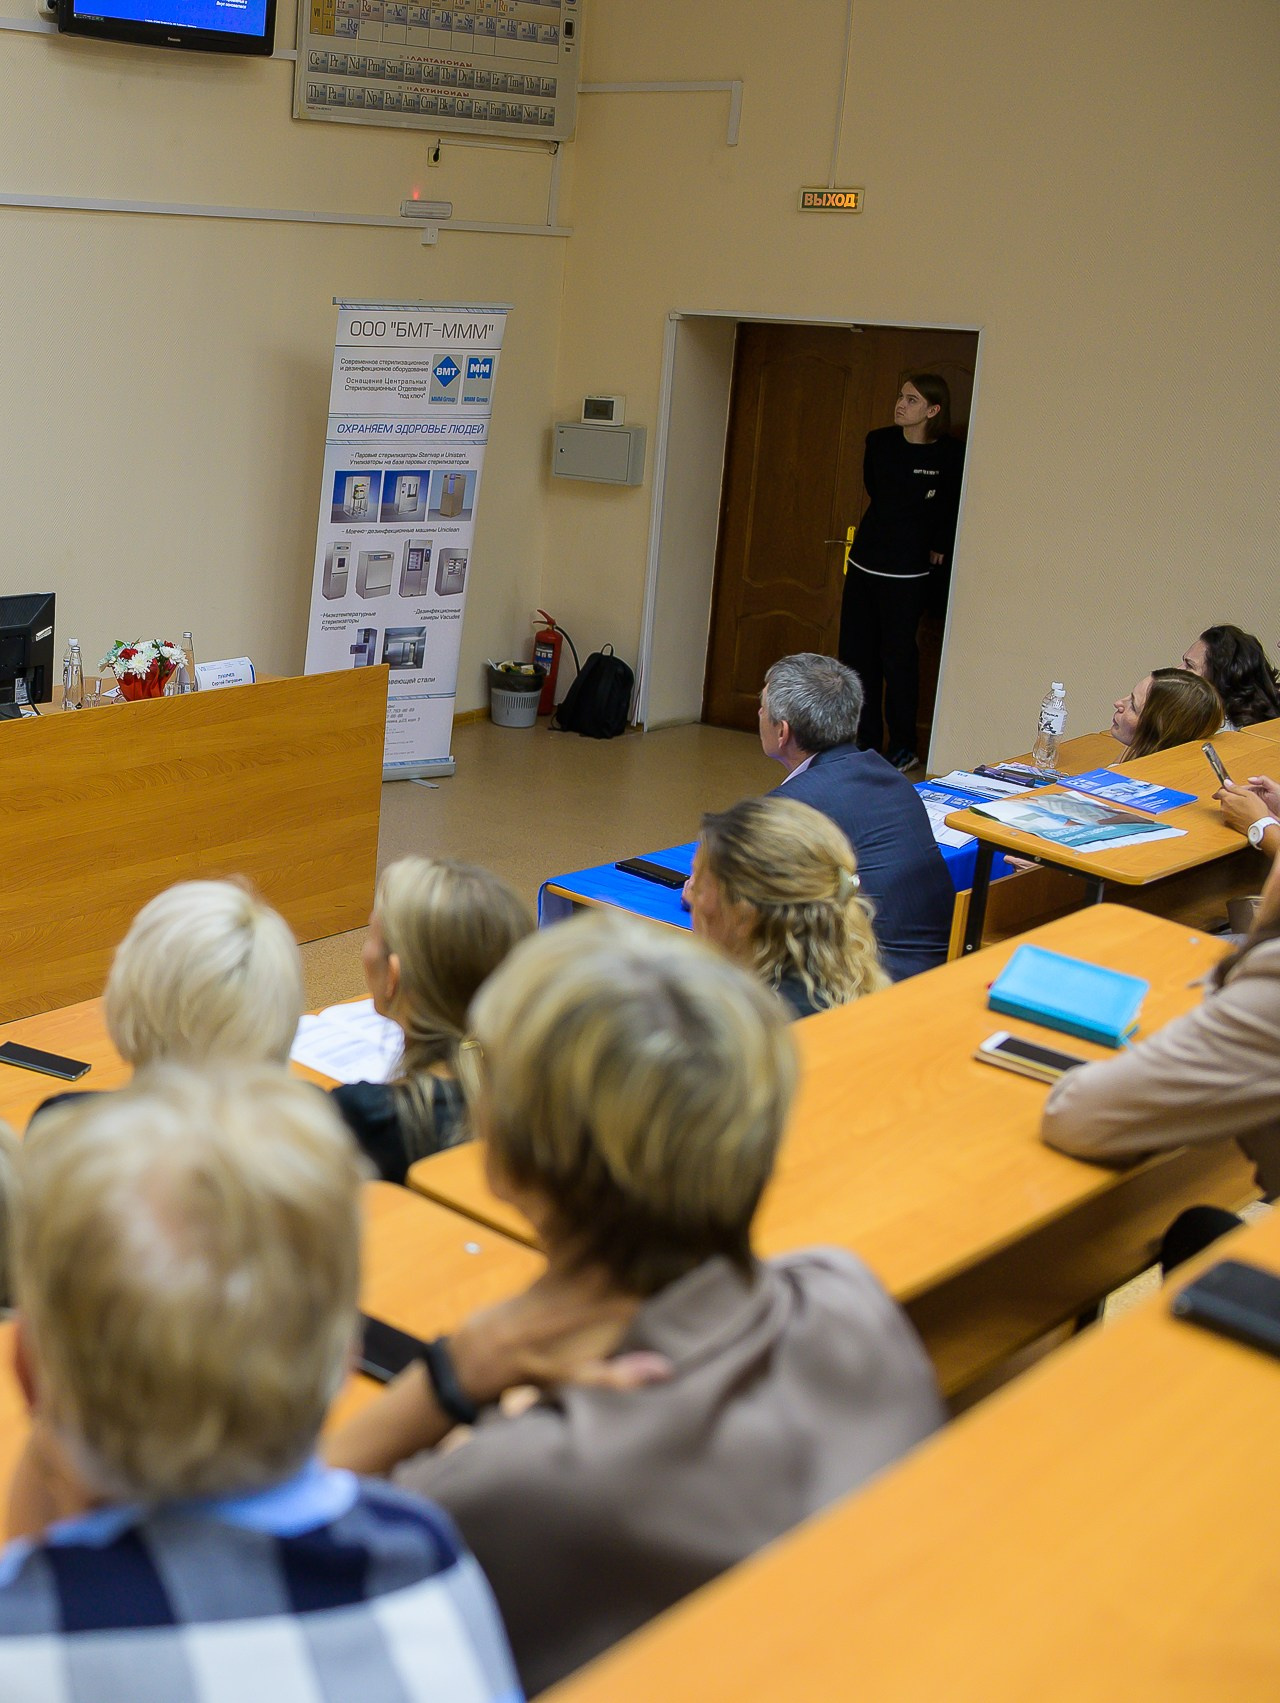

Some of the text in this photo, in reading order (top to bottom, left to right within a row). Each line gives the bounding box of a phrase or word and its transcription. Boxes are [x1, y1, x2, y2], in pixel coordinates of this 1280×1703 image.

[347, 19, 359, 34] Rg
[804, 193, 856, 208] ВЫХОД
[350, 320, 386, 337] ООО
[340, 358, 430, 368] Современное стерилизационное
[344, 365, 392, 373] дезинфекционное
[392, 366, 429, 374] оборудование
[346, 377, 428, 386] Оснащение Центральных
[344, 385, 427, 393] Стерилизационных Отделений
[337, 423, 485, 435] ОХРАНЯЕМ ЗДОРОВЬЕ ЛЮДЕЙ
